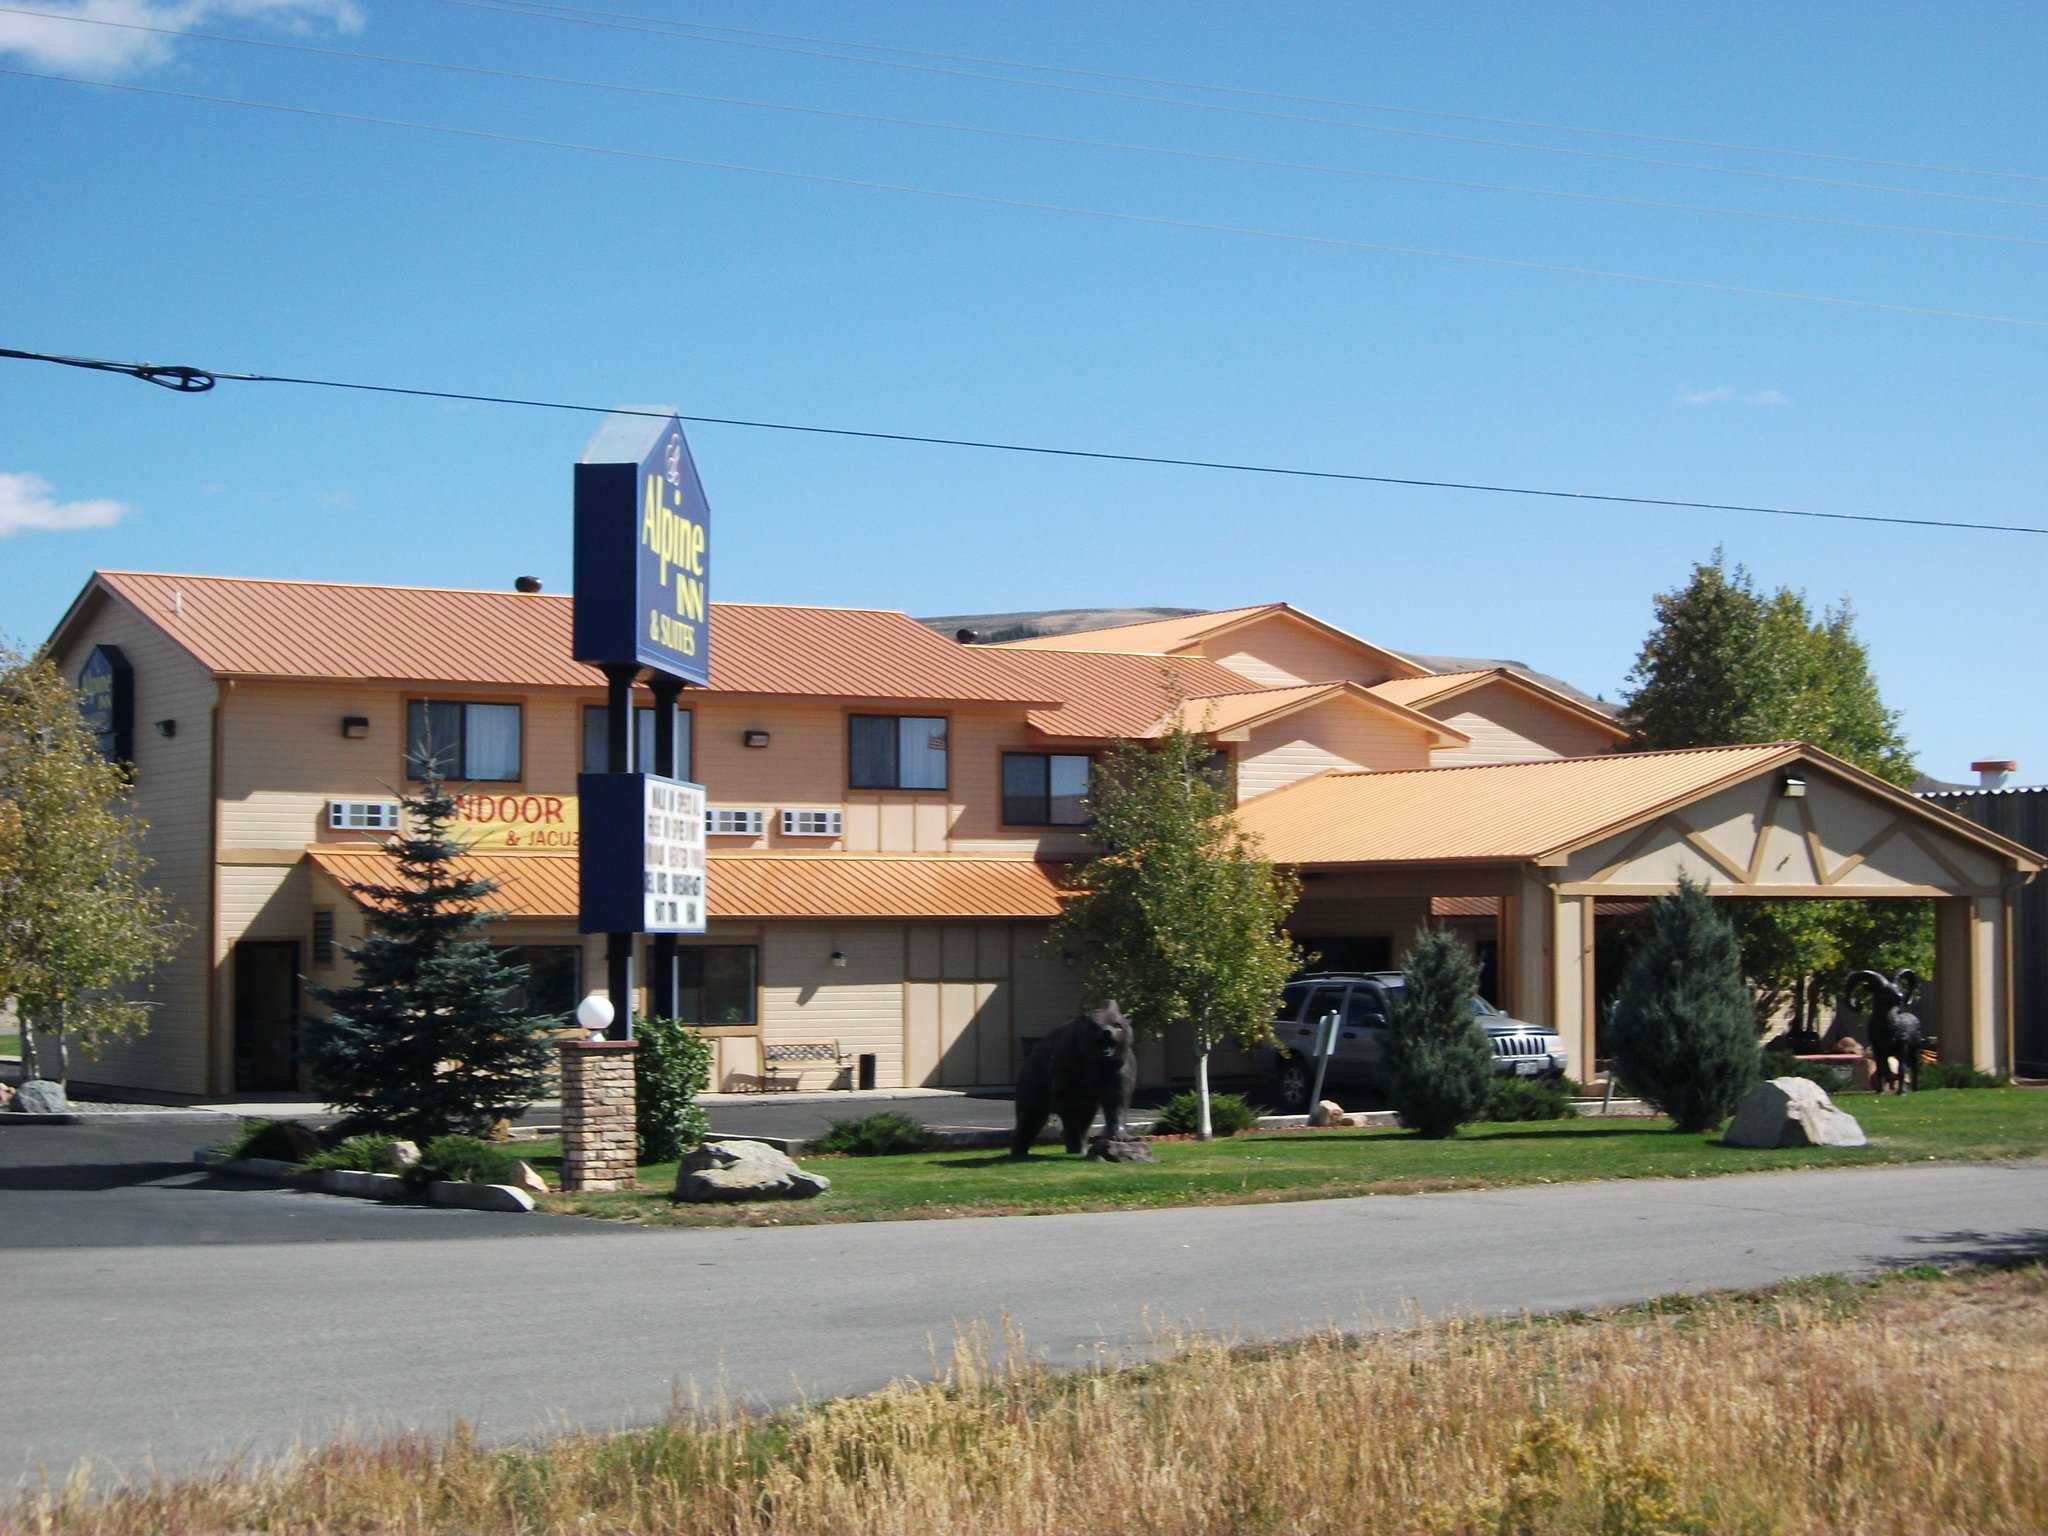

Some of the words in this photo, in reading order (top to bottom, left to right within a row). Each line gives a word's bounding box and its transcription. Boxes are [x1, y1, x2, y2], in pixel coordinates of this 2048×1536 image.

[642, 473, 704, 586] Alpine
[649, 609, 659, 641] &
[660, 613, 695, 656] SUITES
[447, 794, 564, 824] NDOOR
[506, 831, 520, 846] &
